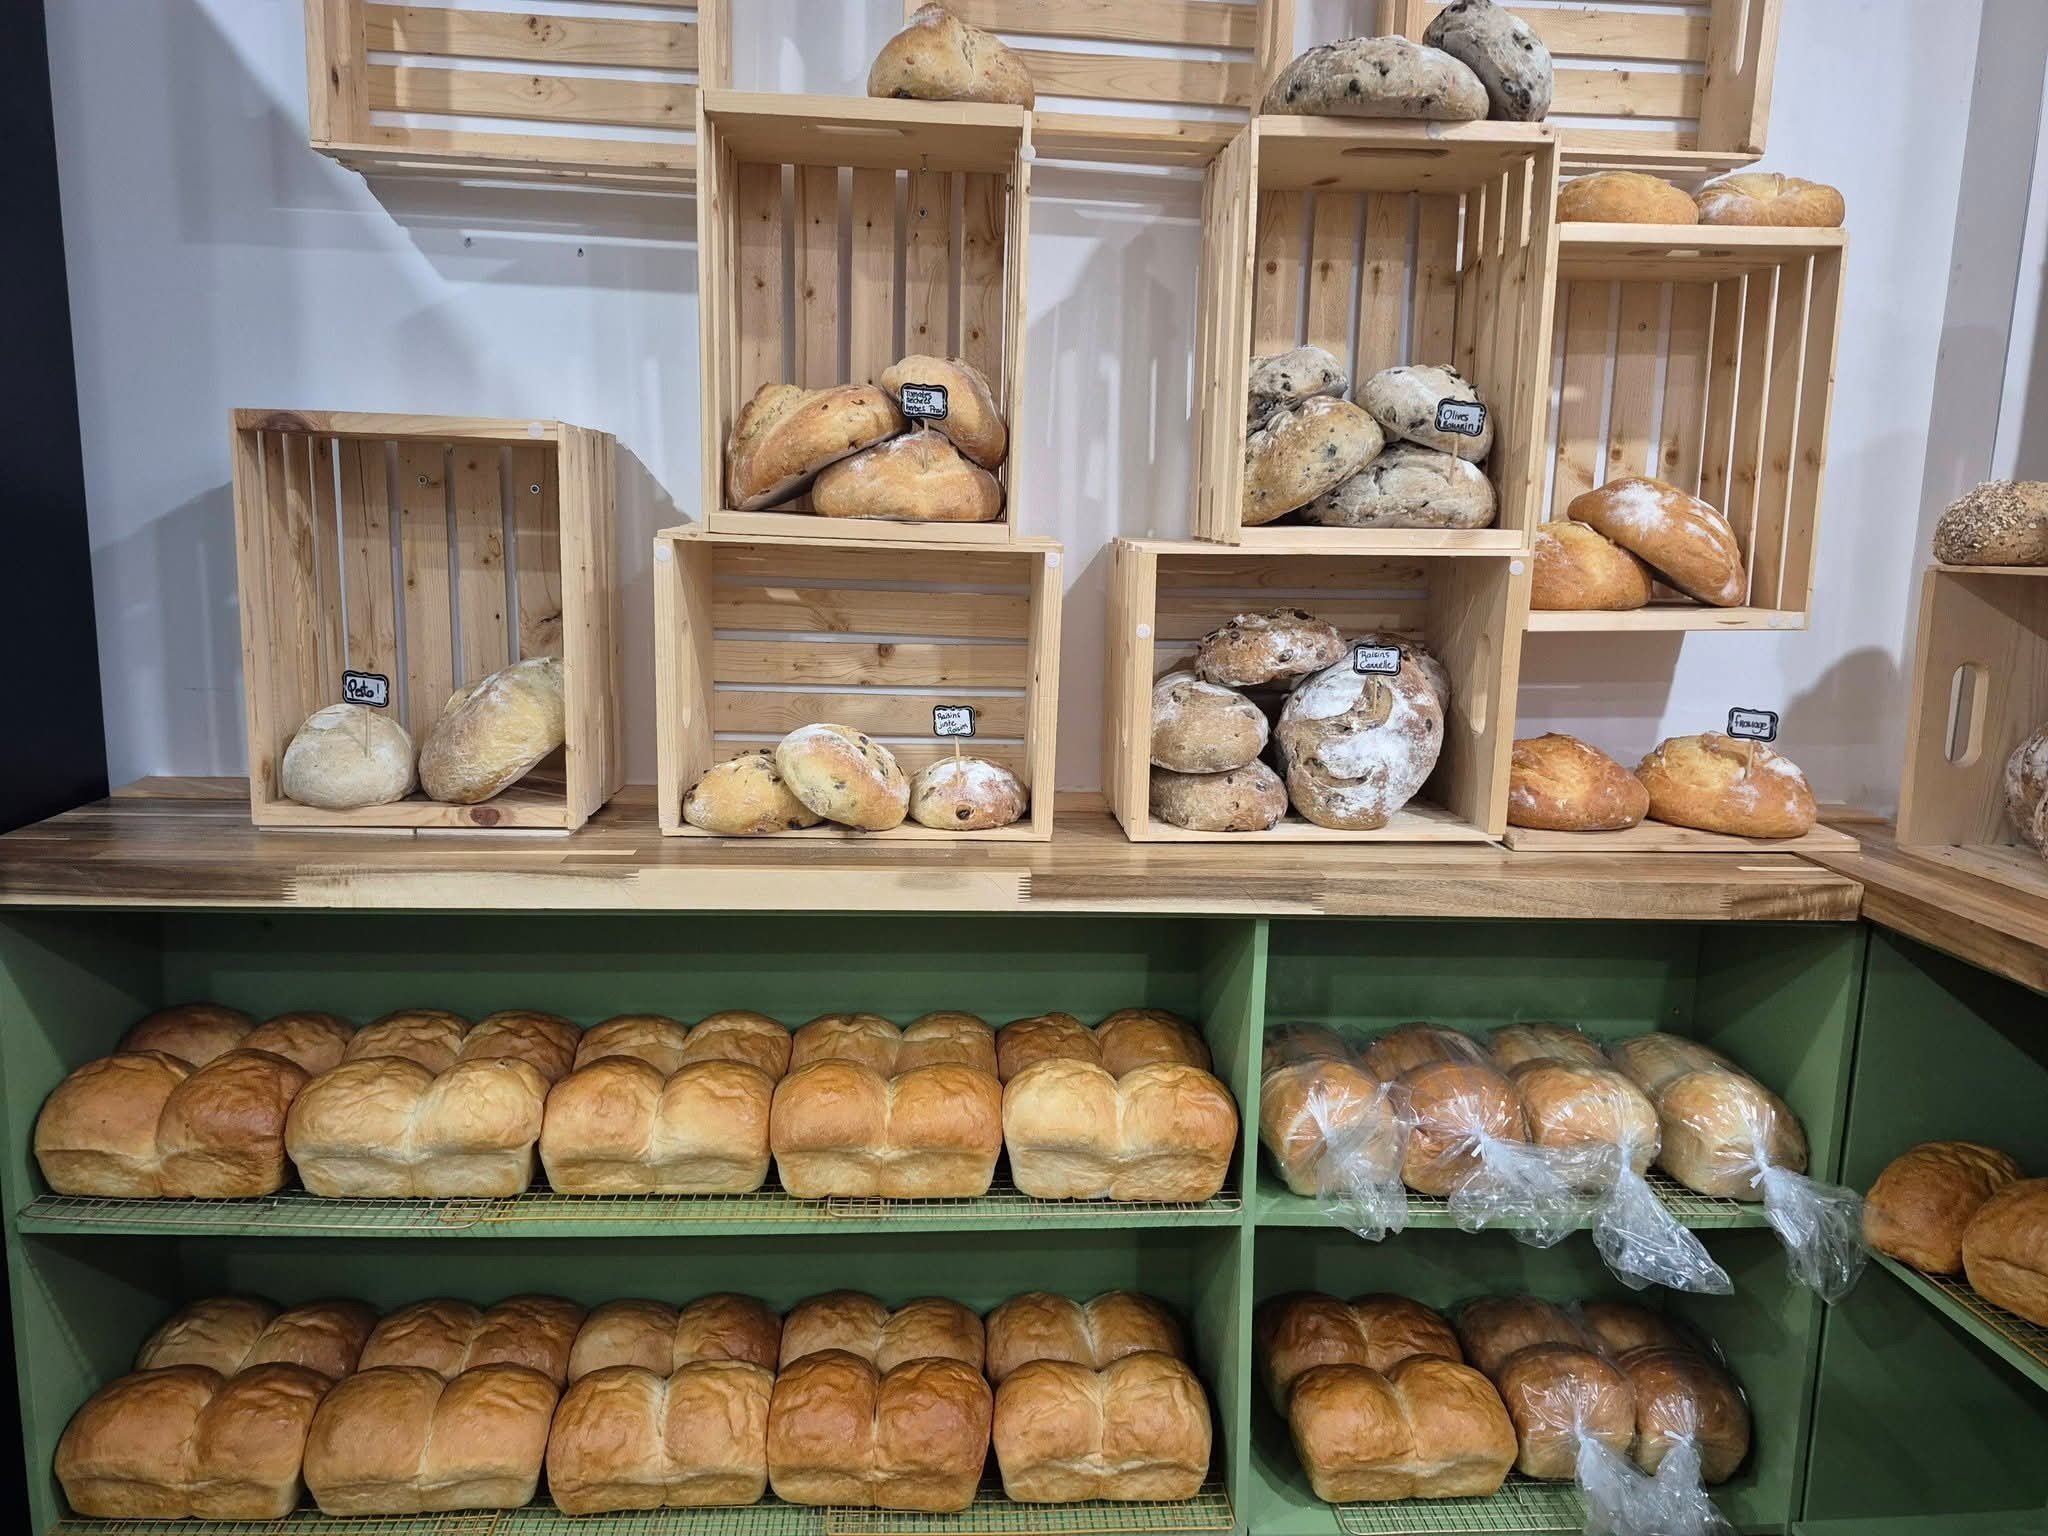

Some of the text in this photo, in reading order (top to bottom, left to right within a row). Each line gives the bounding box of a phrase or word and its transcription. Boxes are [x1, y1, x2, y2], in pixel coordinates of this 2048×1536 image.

[1443, 409, 1469, 421] Olives
[1360, 650, 1390, 661] Raisins
[937, 711, 961, 720] Raisins
